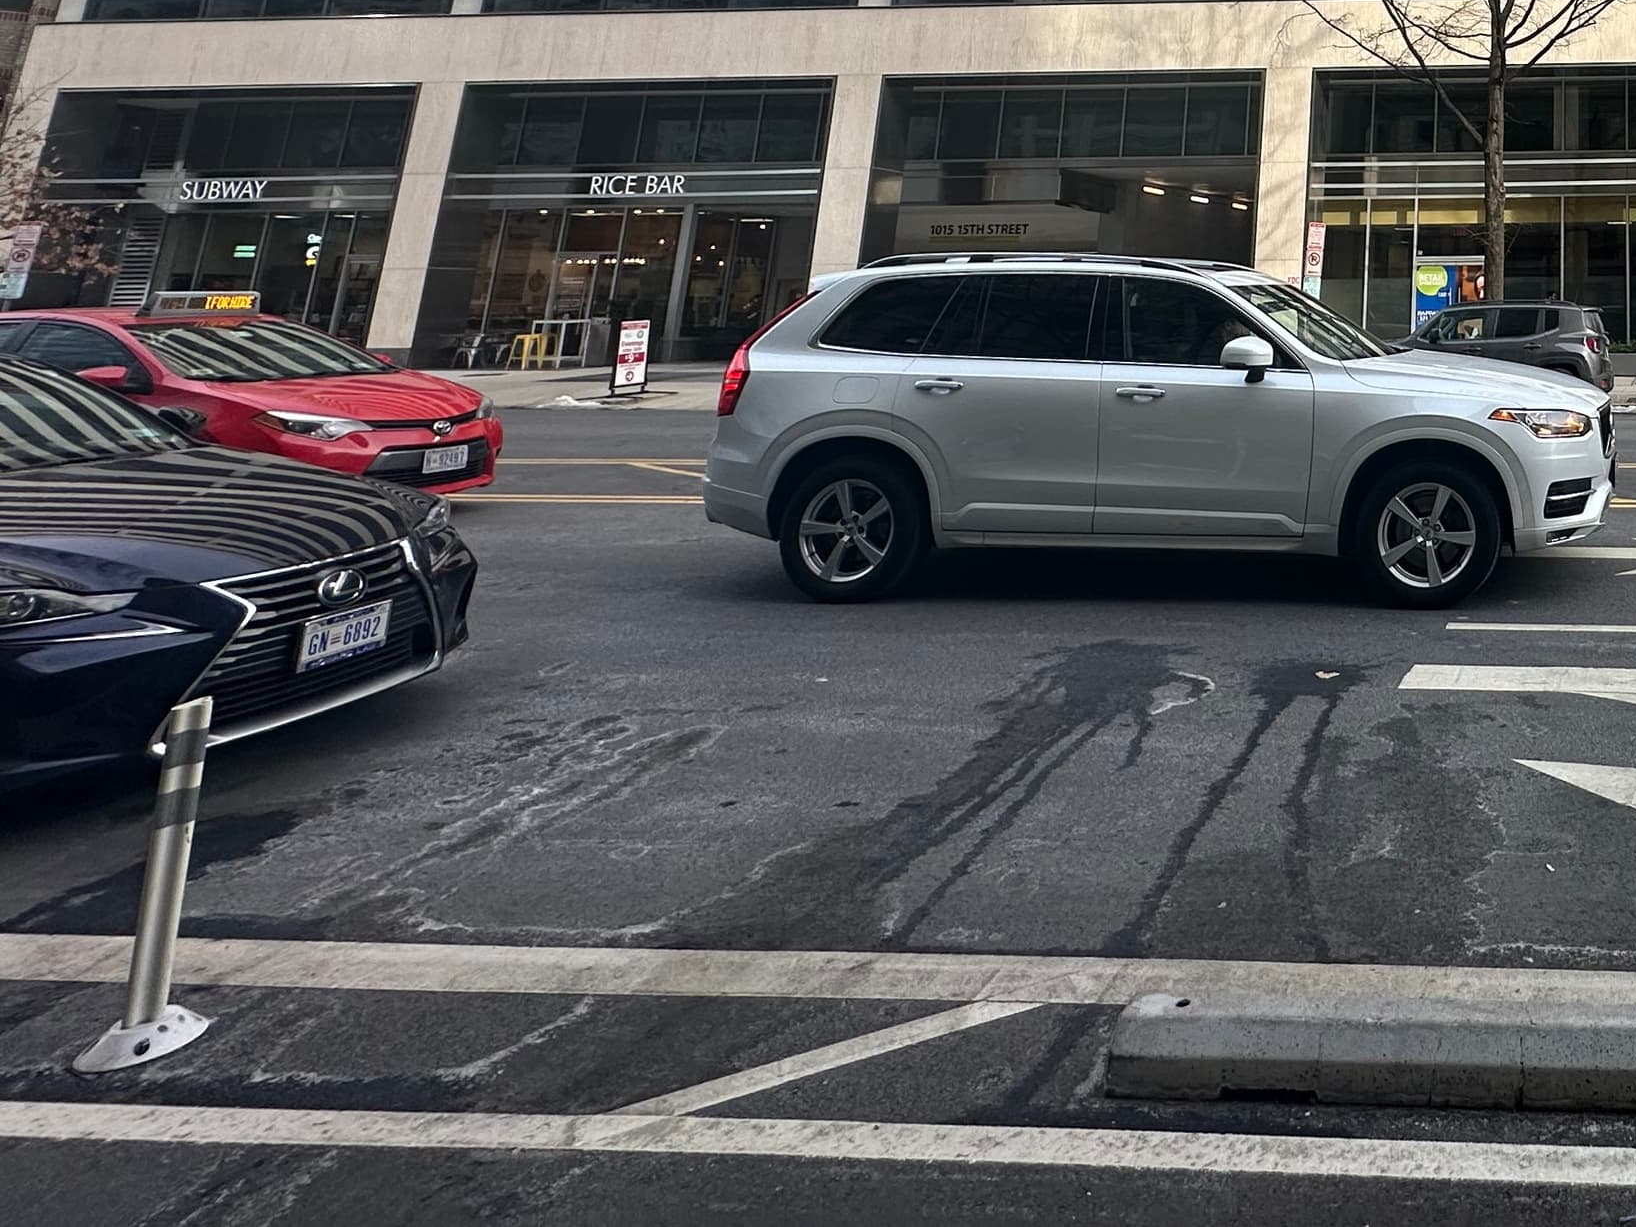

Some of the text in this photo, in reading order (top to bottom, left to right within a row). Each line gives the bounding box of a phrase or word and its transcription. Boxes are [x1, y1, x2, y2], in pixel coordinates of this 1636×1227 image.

[179, 180, 268, 200] SUBWAY
[589, 175, 686, 195] RICE BAR
[930, 223, 1030, 235] 1015 15TH STREET
[343, 616, 381, 646] 6892
